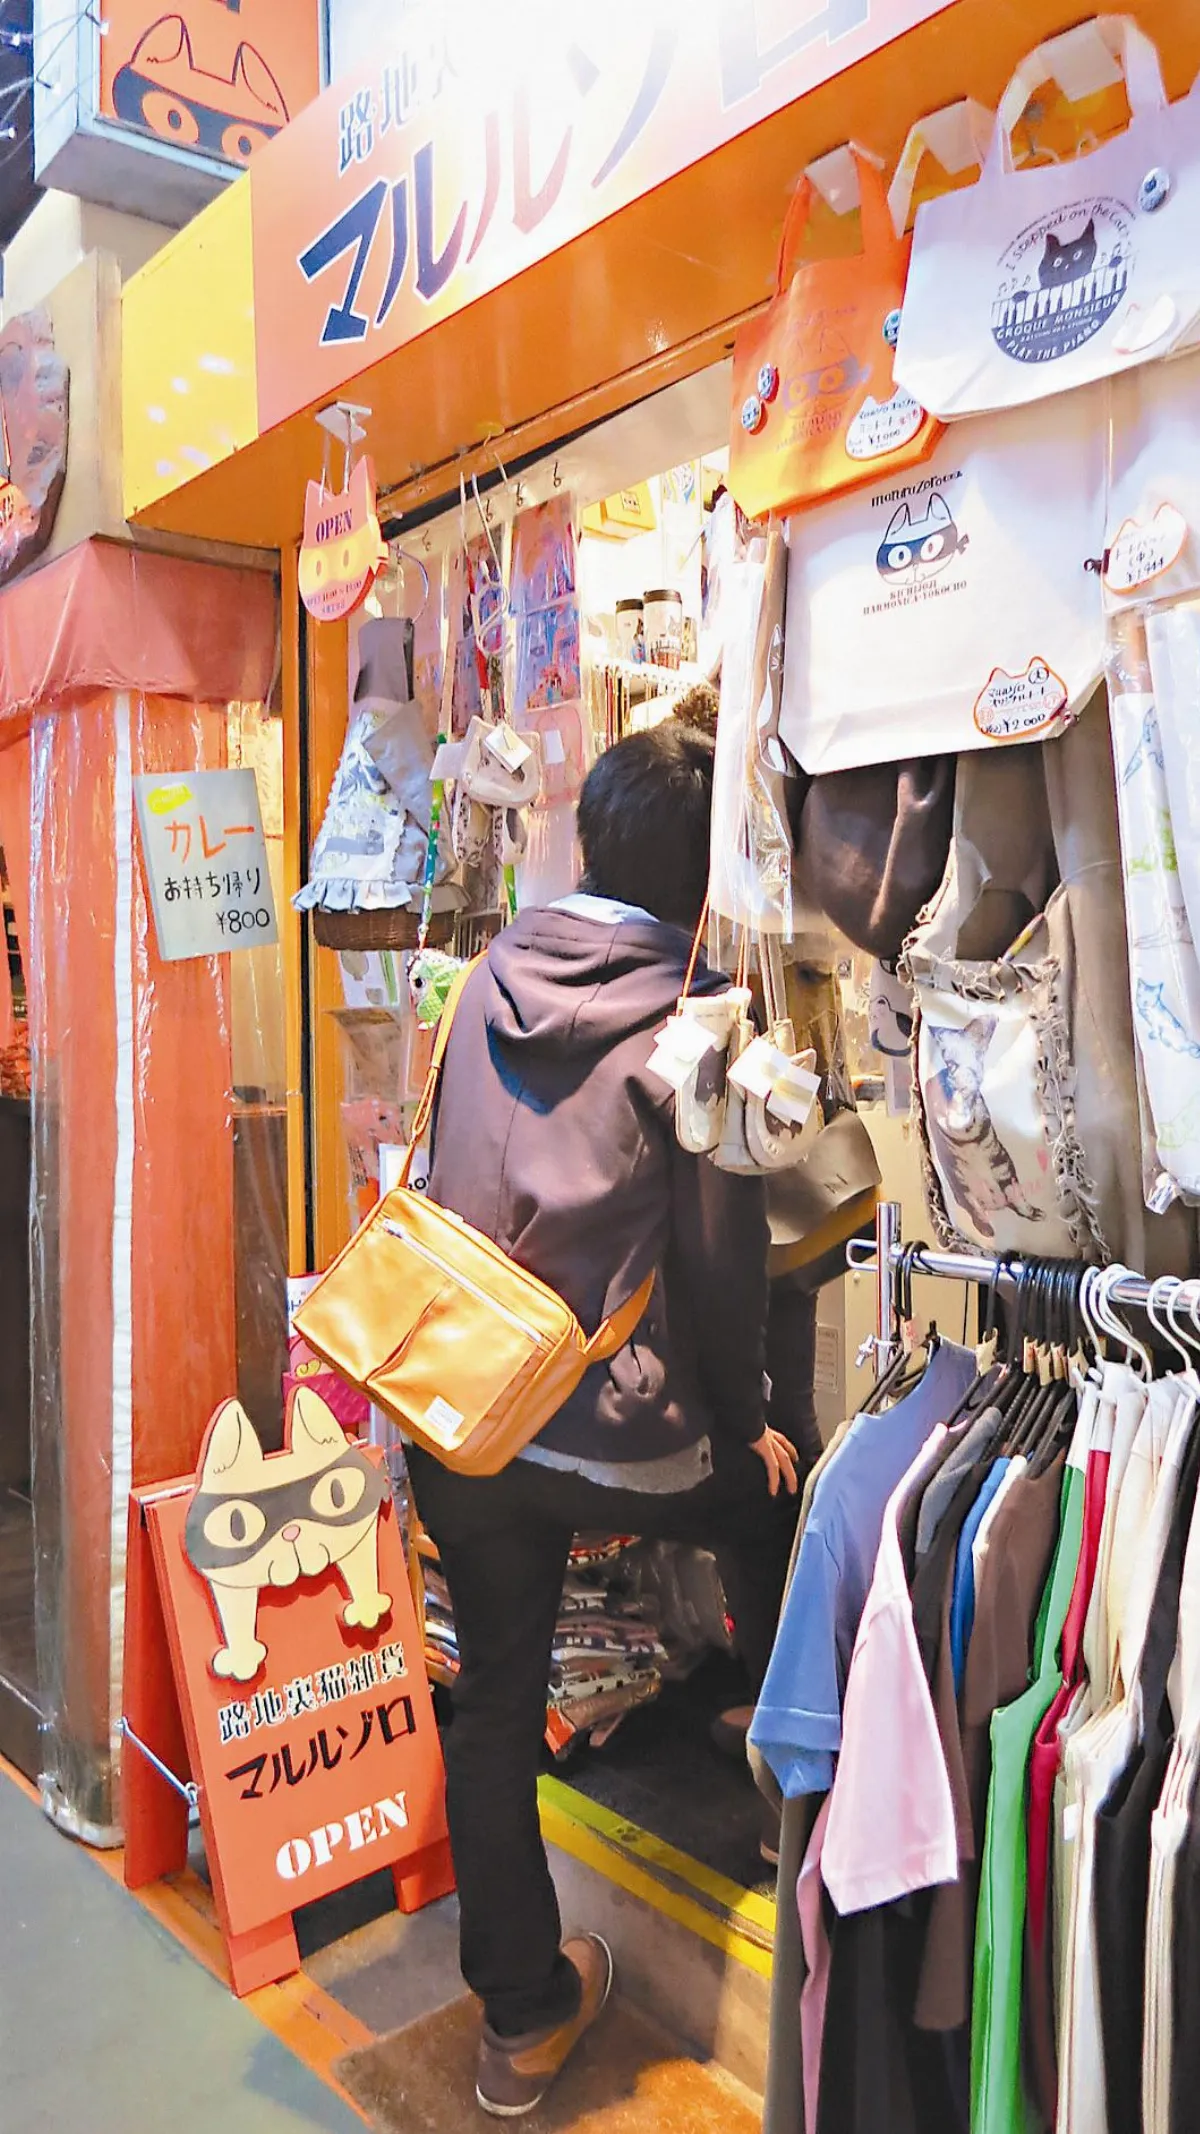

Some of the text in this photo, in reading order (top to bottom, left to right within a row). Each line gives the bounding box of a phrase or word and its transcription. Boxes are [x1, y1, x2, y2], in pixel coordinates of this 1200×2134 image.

[1069, 208, 1088, 221] on
[1091, 202, 1110, 217] the
[996, 318, 1049, 340] CROQUE
[1054, 293, 1120, 324] MONSIEUR
[1036, 345, 1058, 361] THE
[1063, 320, 1100, 352] PIANO
[315, 508, 353, 544] OPEN
[164, 815, 255, 864] カレー
[164, 867, 262, 901] お持ち帰り
[216, 907, 271, 935] ¥800
[219, 1642, 408, 1743] 路地裏猫雑貨
[224, 1694, 417, 1800] マルルゾロ
[275, 1791, 408, 1880] OPEN
